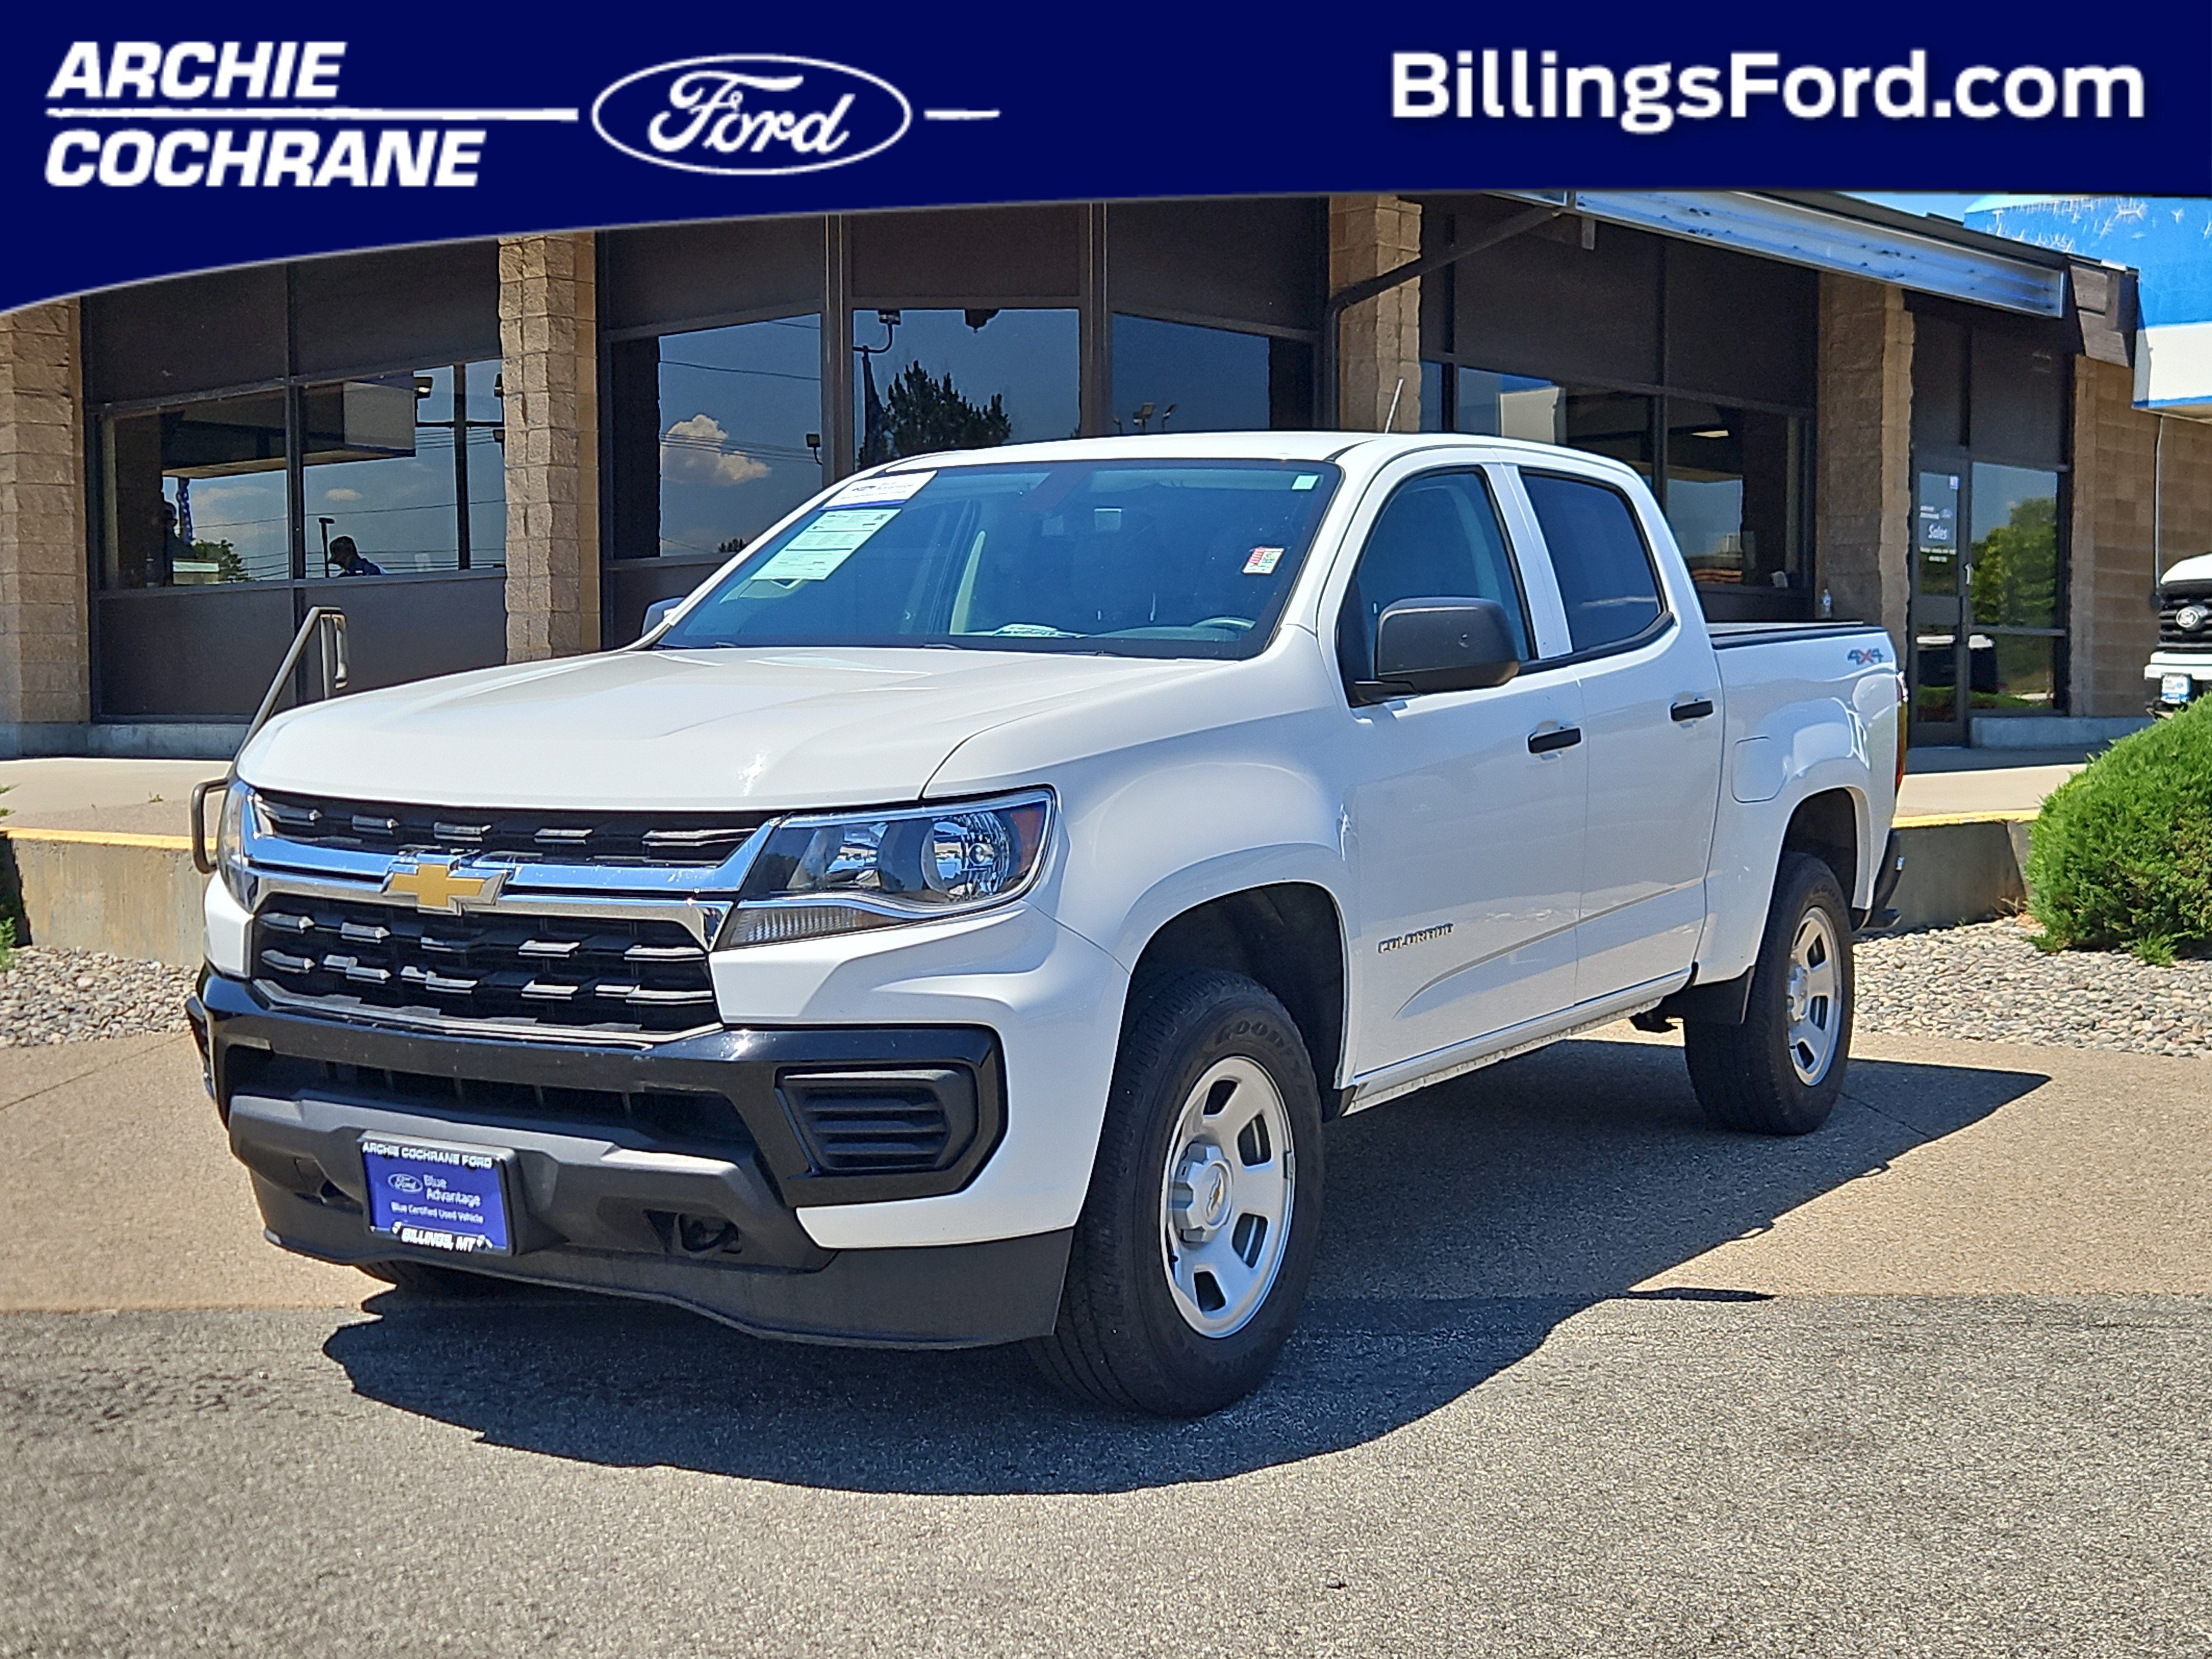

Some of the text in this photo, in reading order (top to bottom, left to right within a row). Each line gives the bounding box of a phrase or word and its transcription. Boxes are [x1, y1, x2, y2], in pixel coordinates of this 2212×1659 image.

[1928, 522, 1948, 541] Sales
[1378, 922, 1454, 954] COLORADO
[362, 1141, 493, 1169] ARCHIE COCHRANE FORD
[423, 1174, 447, 1189] Blue
[426, 1187, 481, 1208] Advantage
[391, 1201, 484, 1224] Blue Certified Used Vehicle
[456, 1236, 477, 1253] MT
